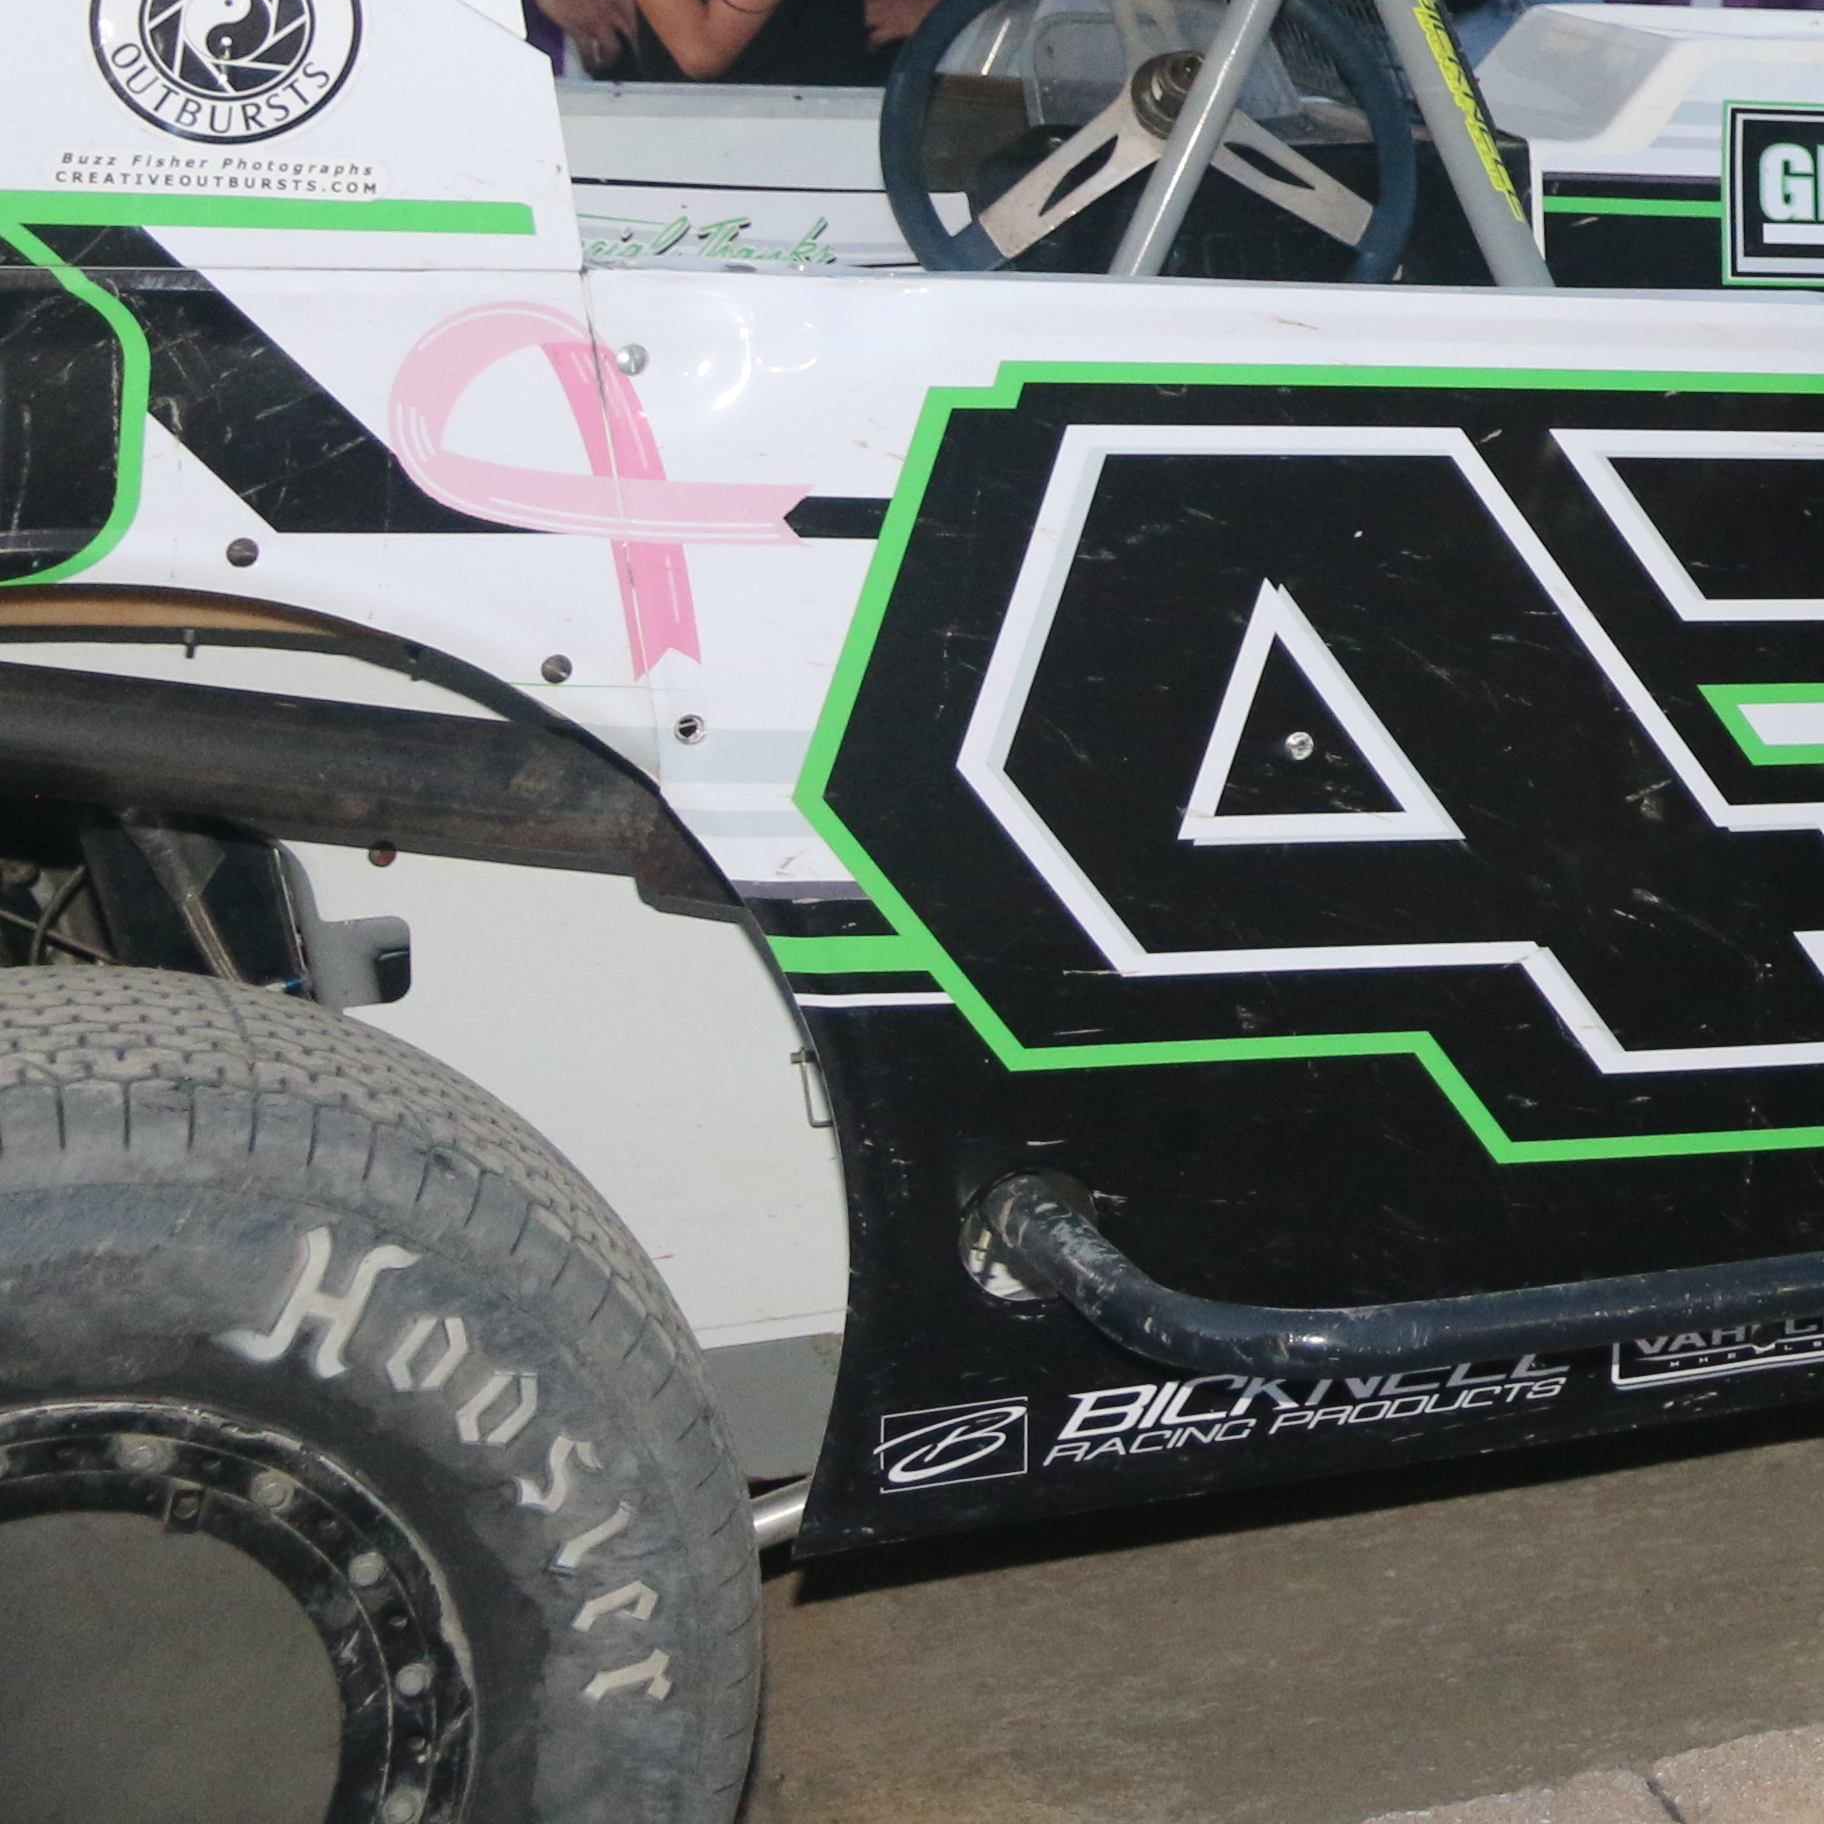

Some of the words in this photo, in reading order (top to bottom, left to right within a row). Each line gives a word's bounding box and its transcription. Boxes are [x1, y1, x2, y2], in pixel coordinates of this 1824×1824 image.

[111, 41, 332, 134] OUTBURSTS
[55, 171, 378, 194] CREATIVEOUTBURSTS.COM
[62, 152, 118, 168] Buzz
[131, 154, 209, 171] Fisher
[222, 157, 374, 178] Photographs
[1042, 1422, 1252, 1467] RACING
[1268, 1376, 1569, 1436] PRODUCTS
